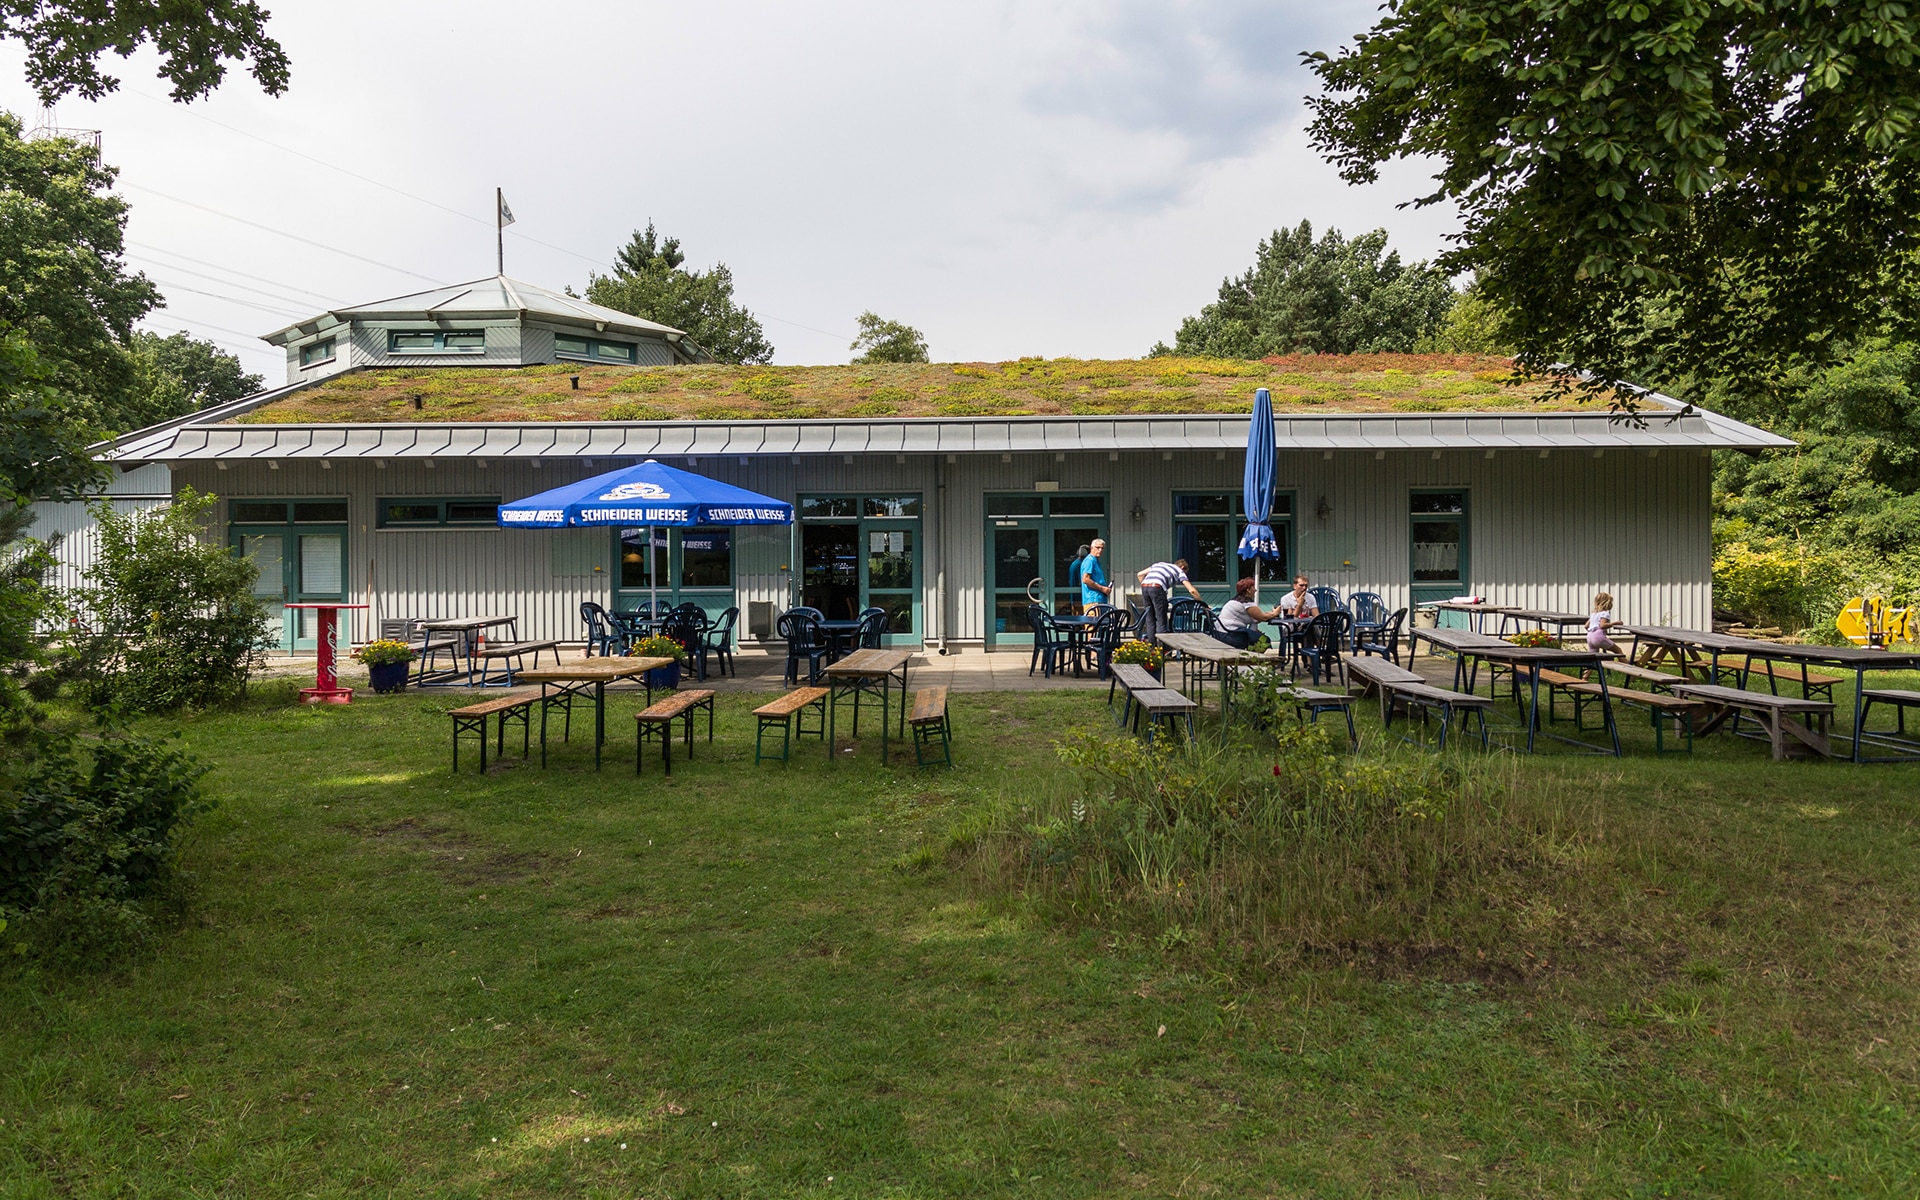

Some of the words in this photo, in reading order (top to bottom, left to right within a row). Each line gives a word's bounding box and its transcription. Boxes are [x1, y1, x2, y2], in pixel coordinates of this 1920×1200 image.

[501, 510, 538, 522] SCHNEIDER
[535, 510, 564, 522] WEISSE
[581, 509, 643, 521] SCHNEIDER
[646, 509, 688, 521] WEISSE
[708, 508, 755, 520] SCHNEIDER
[755, 509, 785, 521] WEISSE
